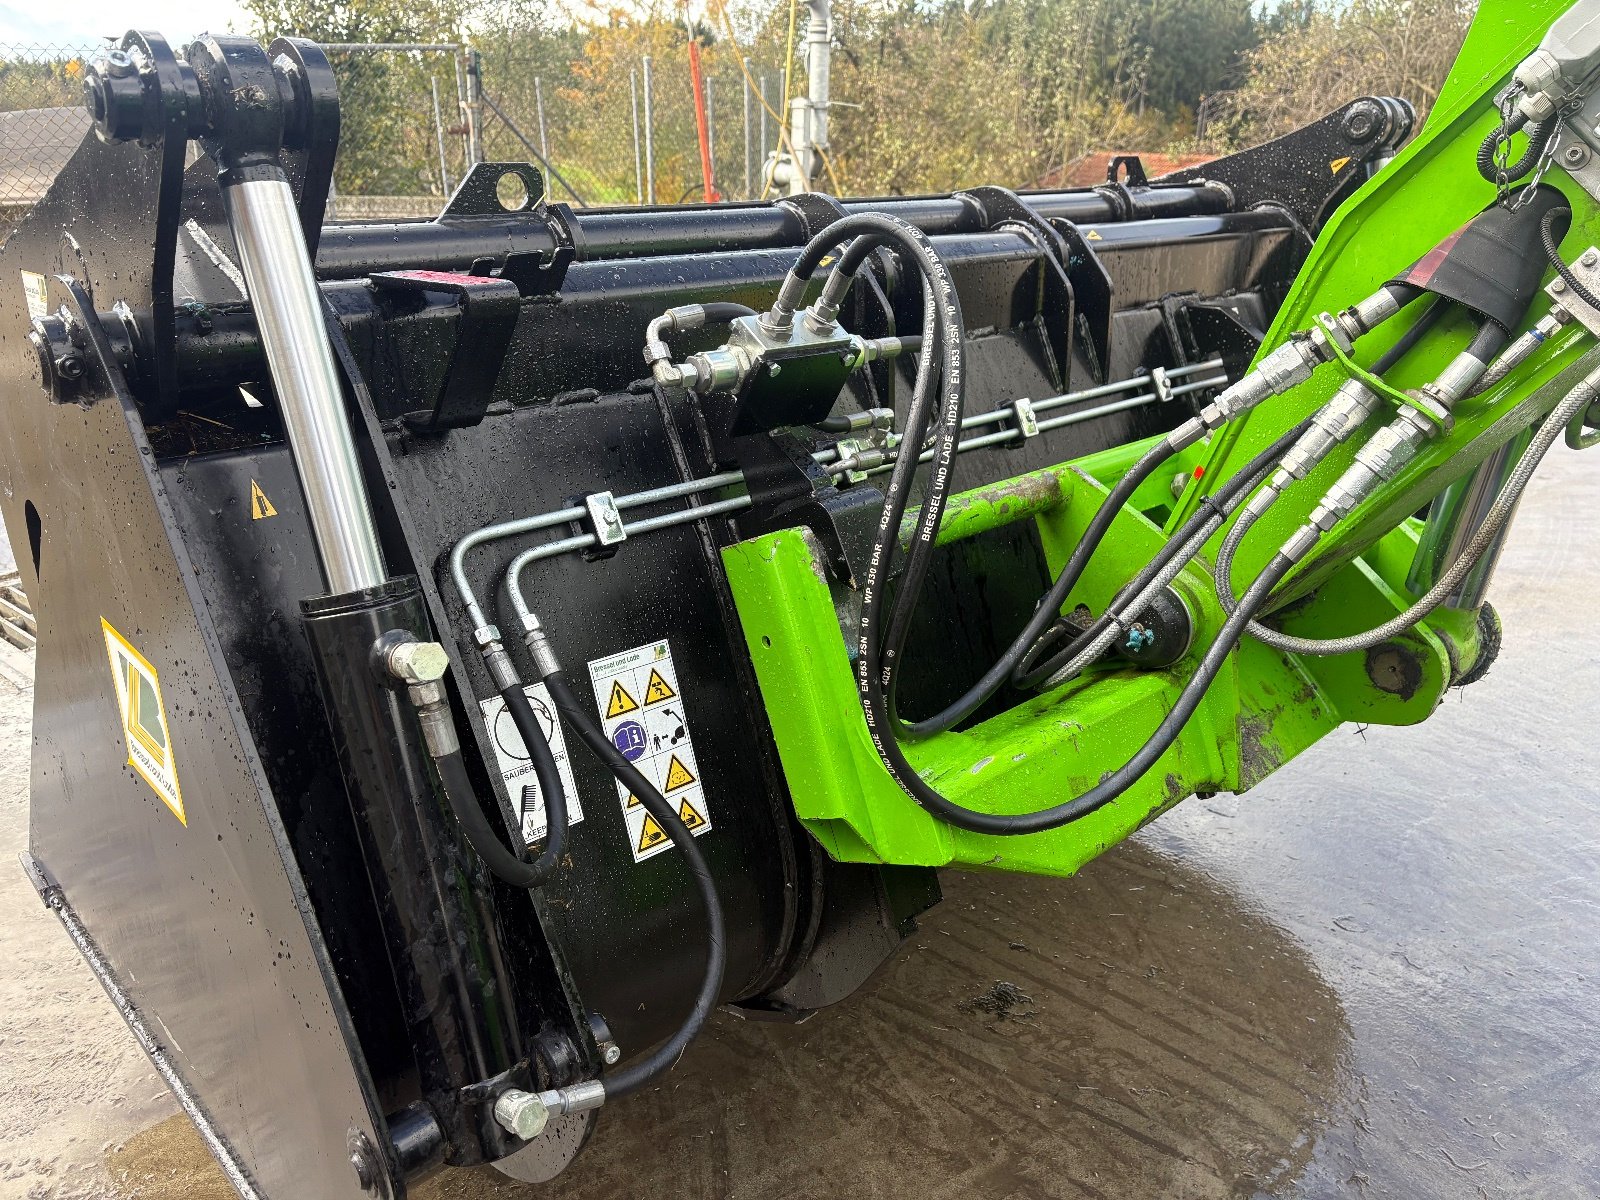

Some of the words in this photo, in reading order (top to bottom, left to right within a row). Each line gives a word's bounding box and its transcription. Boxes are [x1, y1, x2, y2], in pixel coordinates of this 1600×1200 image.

[925, 246, 939, 263] BAR
[935, 263, 946, 278] 330
[940, 280, 951, 294] WP
[947, 305, 956, 316] 10
[922, 321, 935, 366] BRESSEL
[951, 350, 960, 367] 853
[951, 369, 960, 384] EN
[947, 393, 959, 426] HD210
[941, 435, 954, 465] LADE
[935, 467, 948, 490] UND
[880, 504, 893, 530] 4Q24
[921, 494, 942, 542] BRESSEL
[871, 543, 883, 565] BAR
[867, 568, 877, 585] 330
[864, 588, 873, 604] WP
[861, 617, 869, 628] 10
[860, 636, 868, 656] 2SN
[859, 660, 867, 676] 853
[882, 666, 892, 686] 4Q24
[861, 677, 869, 692] EN
[863, 700, 876, 727] HD210
[872, 733, 887, 756] LADE
[504, 765, 535, 781] SAUBER
[882, 757, 896, 775] UND
